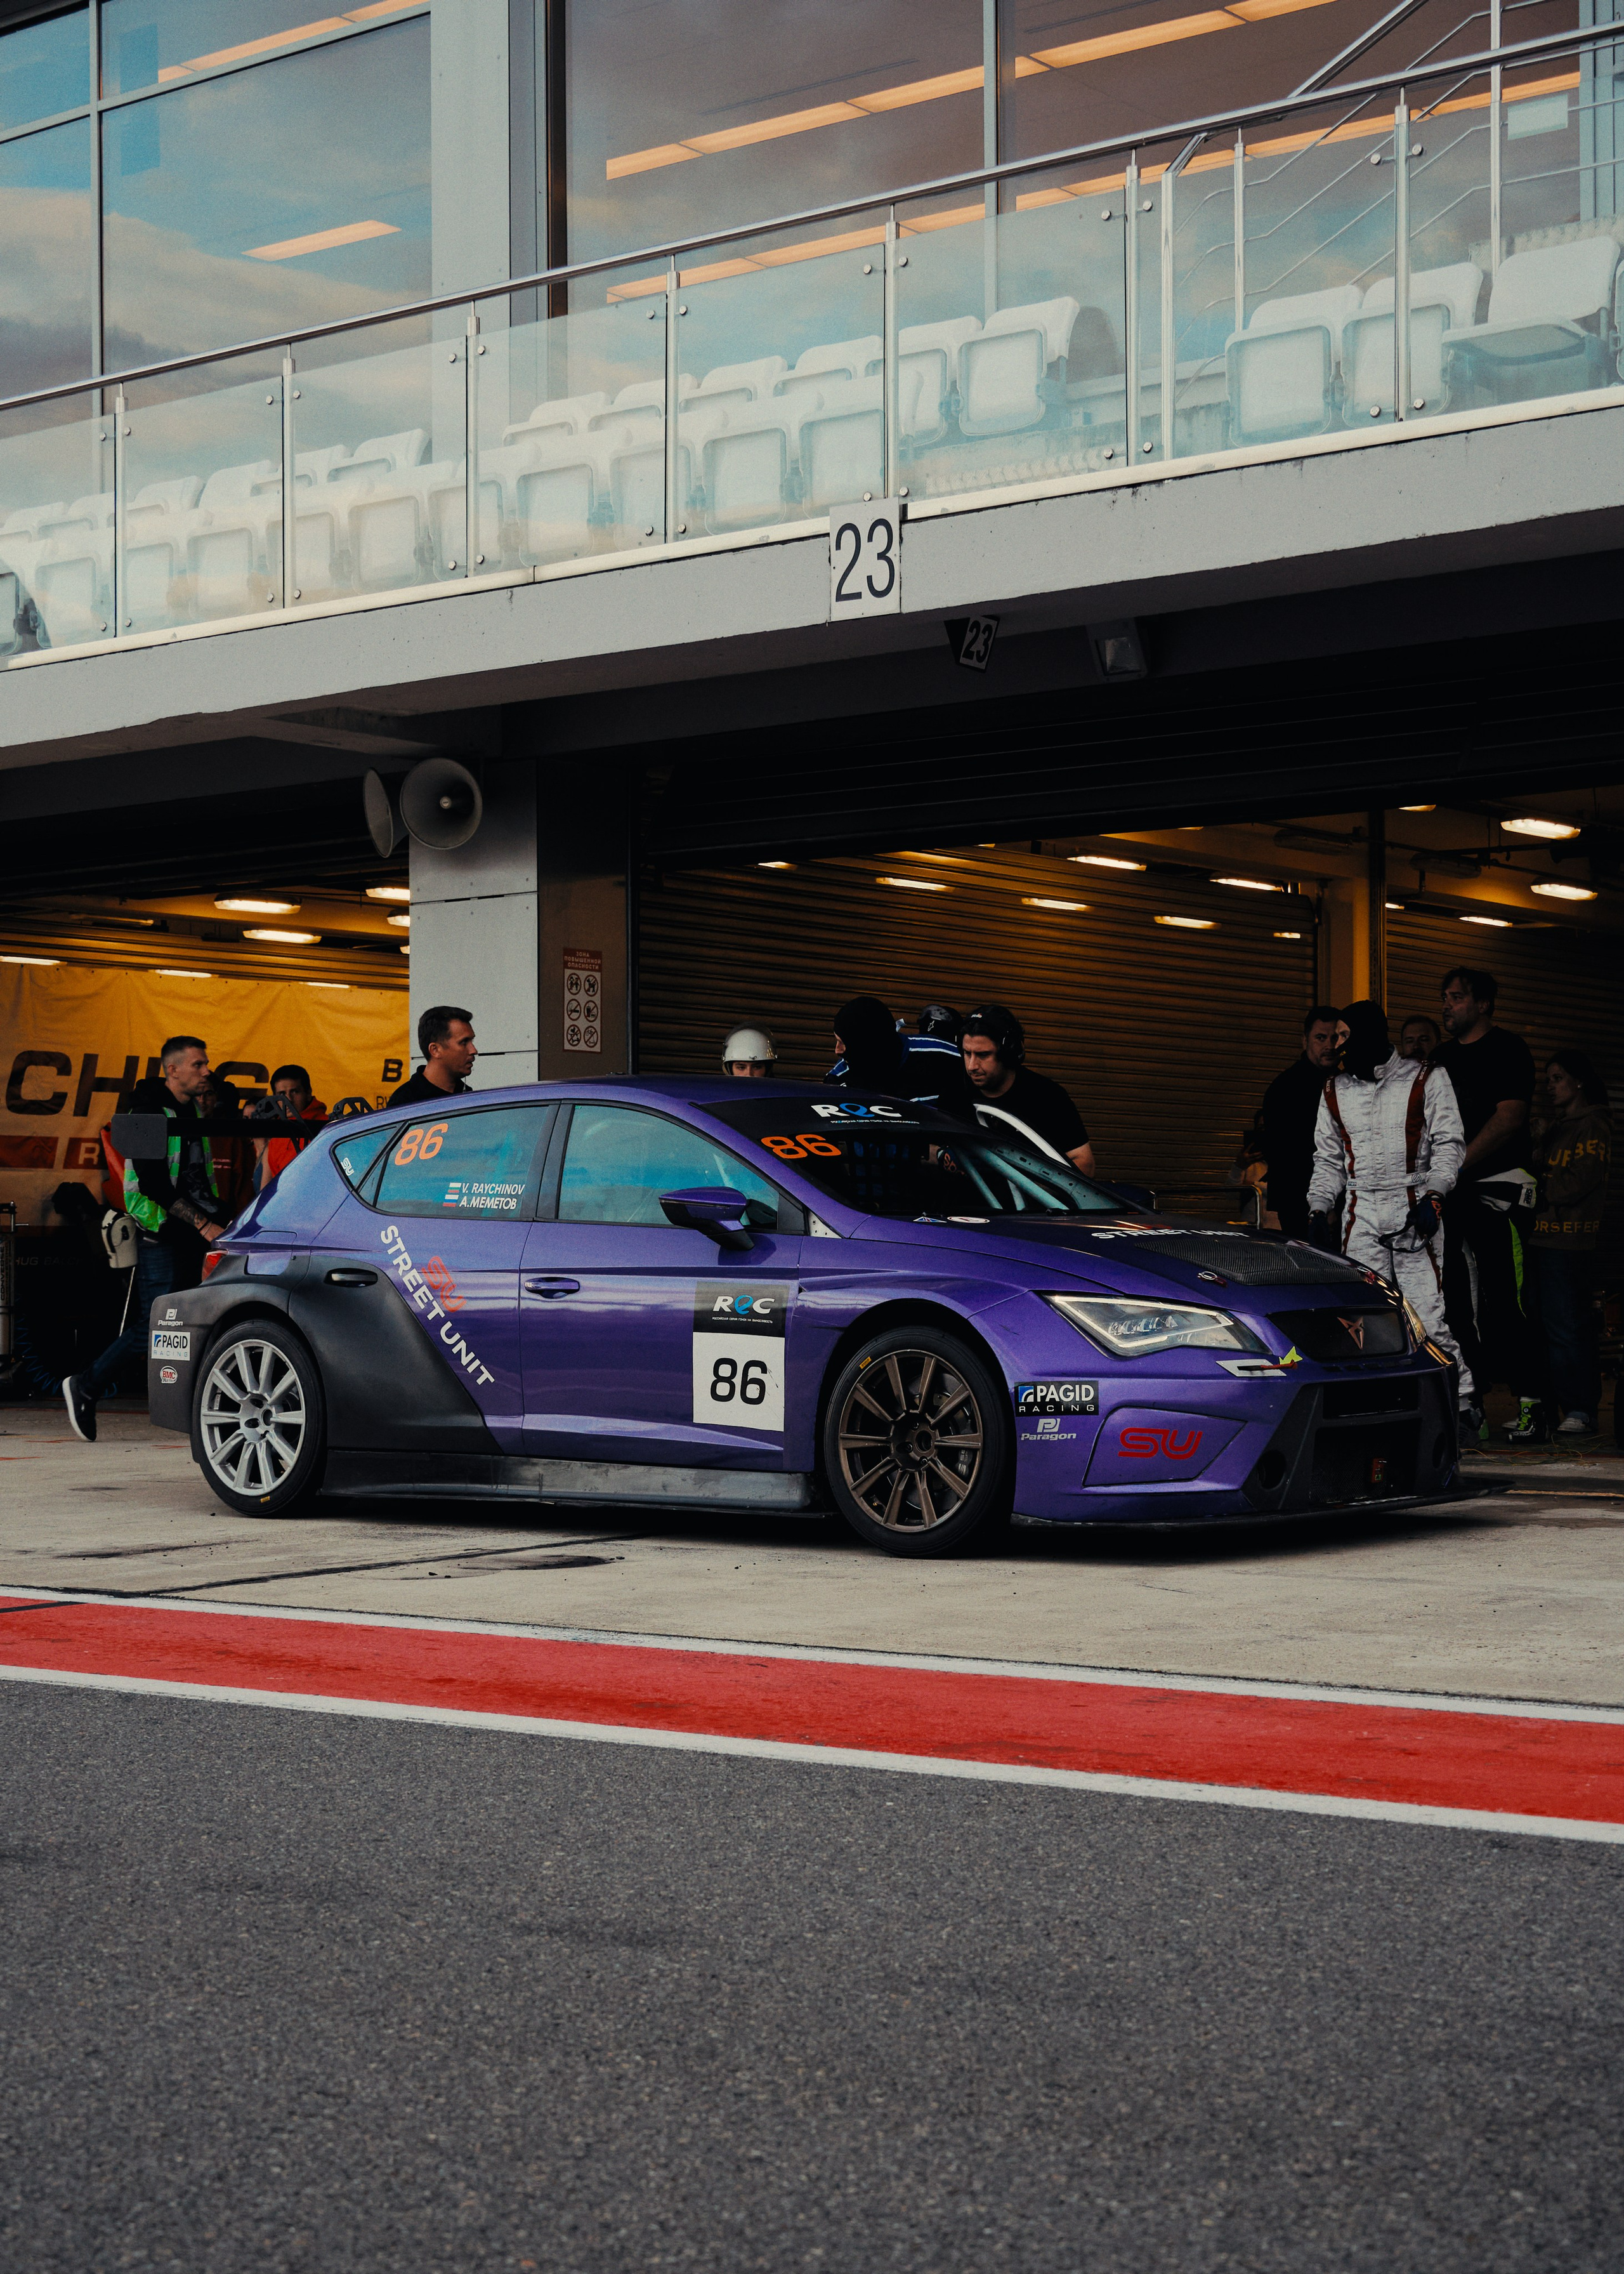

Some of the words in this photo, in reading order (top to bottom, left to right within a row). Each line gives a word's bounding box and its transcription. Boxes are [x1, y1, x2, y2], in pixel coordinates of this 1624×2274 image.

[835, 518, 895, 602] 23
[961, 620, 993, 663] 23
[564, 956, 601, 964] ПОВЫШЕННОЙ
[395, 1123, 449, 1166] 86
[761, 1134, 842, 1159] 86
[461, 1183, 469, 1193] V.
[471, 1183, 525, 1195] RAYCHINOV
[1091, 1229, 1191, 1239] STREET
[381, 1225, 445, 1321] STREET
[440, 1321, 495, 1385] UNIT
[162, 1334, 188, 1349] PAGID
[162, 1370, 176, 1379] BMC
[710, 1358, 768, 1405] 86
[1037, 1384, 1094, 1402] PAGID
[1019, 1404, 1095, 1413] RACING
[1021, 1433, 1077, 1442] Paragon
